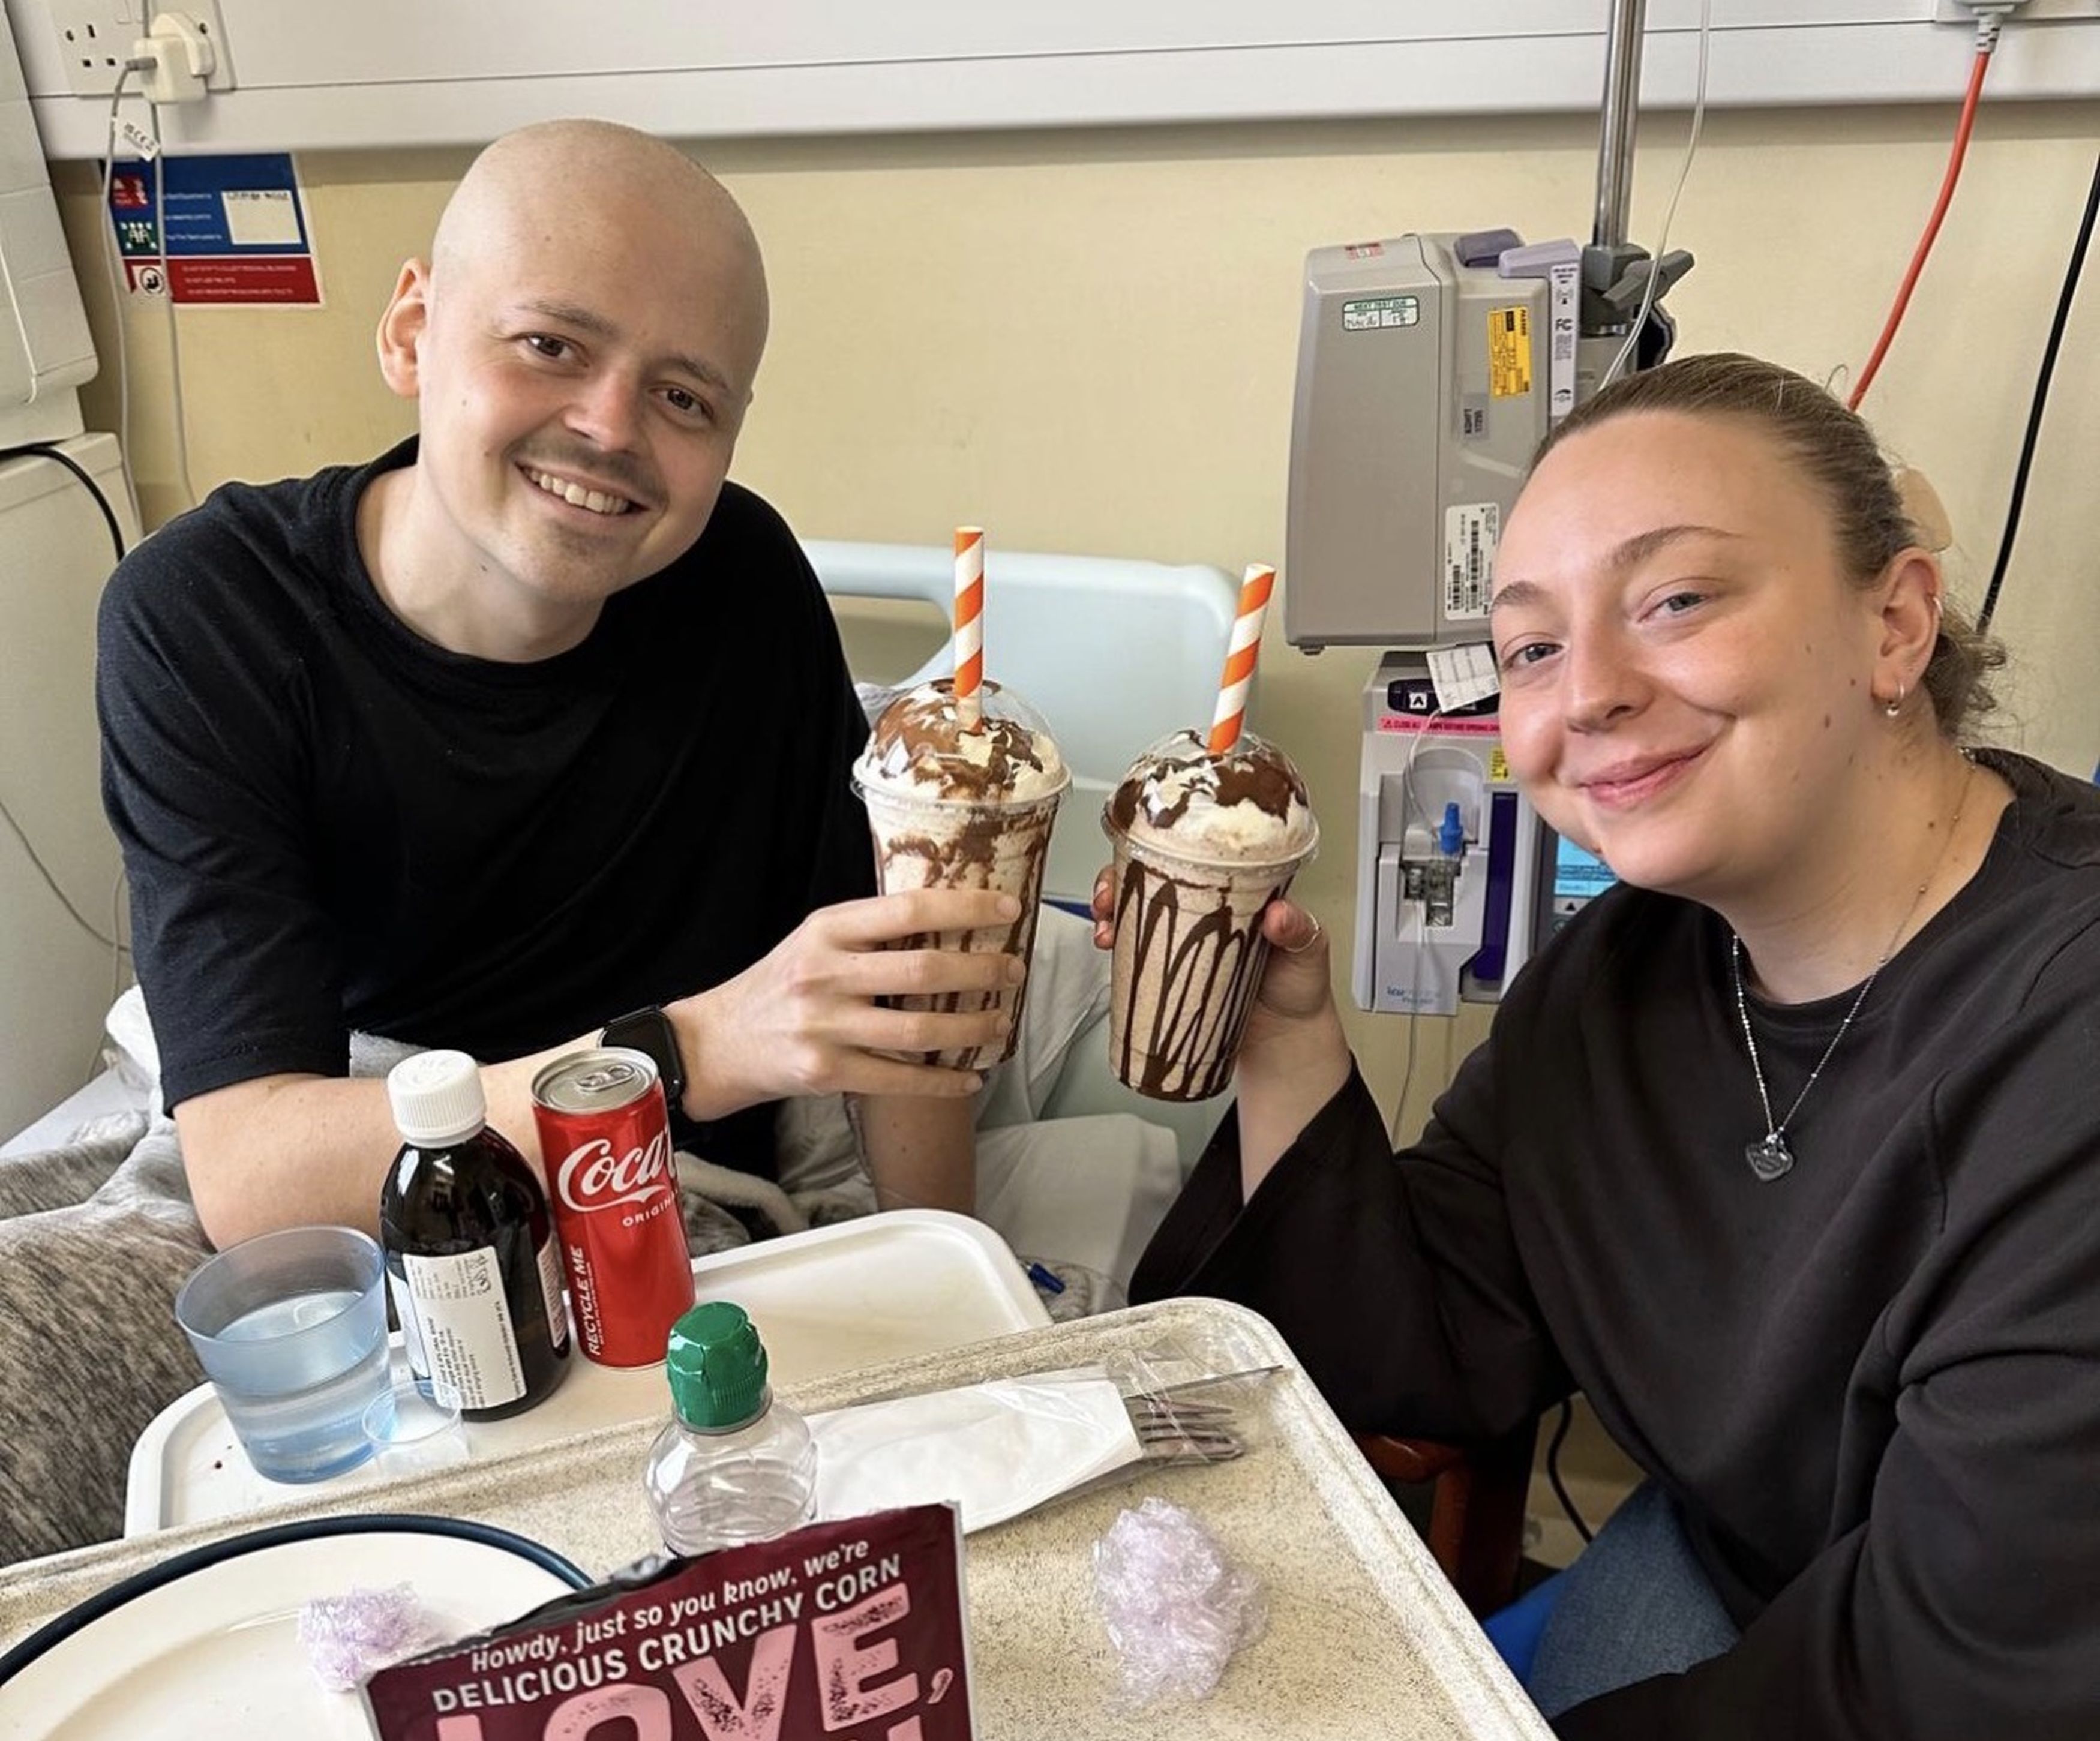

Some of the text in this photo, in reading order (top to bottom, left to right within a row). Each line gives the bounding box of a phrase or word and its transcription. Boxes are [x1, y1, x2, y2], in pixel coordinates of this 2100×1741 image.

[570, 1244, 587, 1275] ME
[576, 1276, 601, 1356] RECYCLE
[432, 1554, 900, 1712] DELICIOUS CRUNCHY CORN
[574, 1610, 628, 1654] just
[634, 1606, 662, 1629] so
[669, 1592, 716, 1627] you
[805, 1540, 869, 1578] we're
[436, 1582, 954, 1741] VE,
